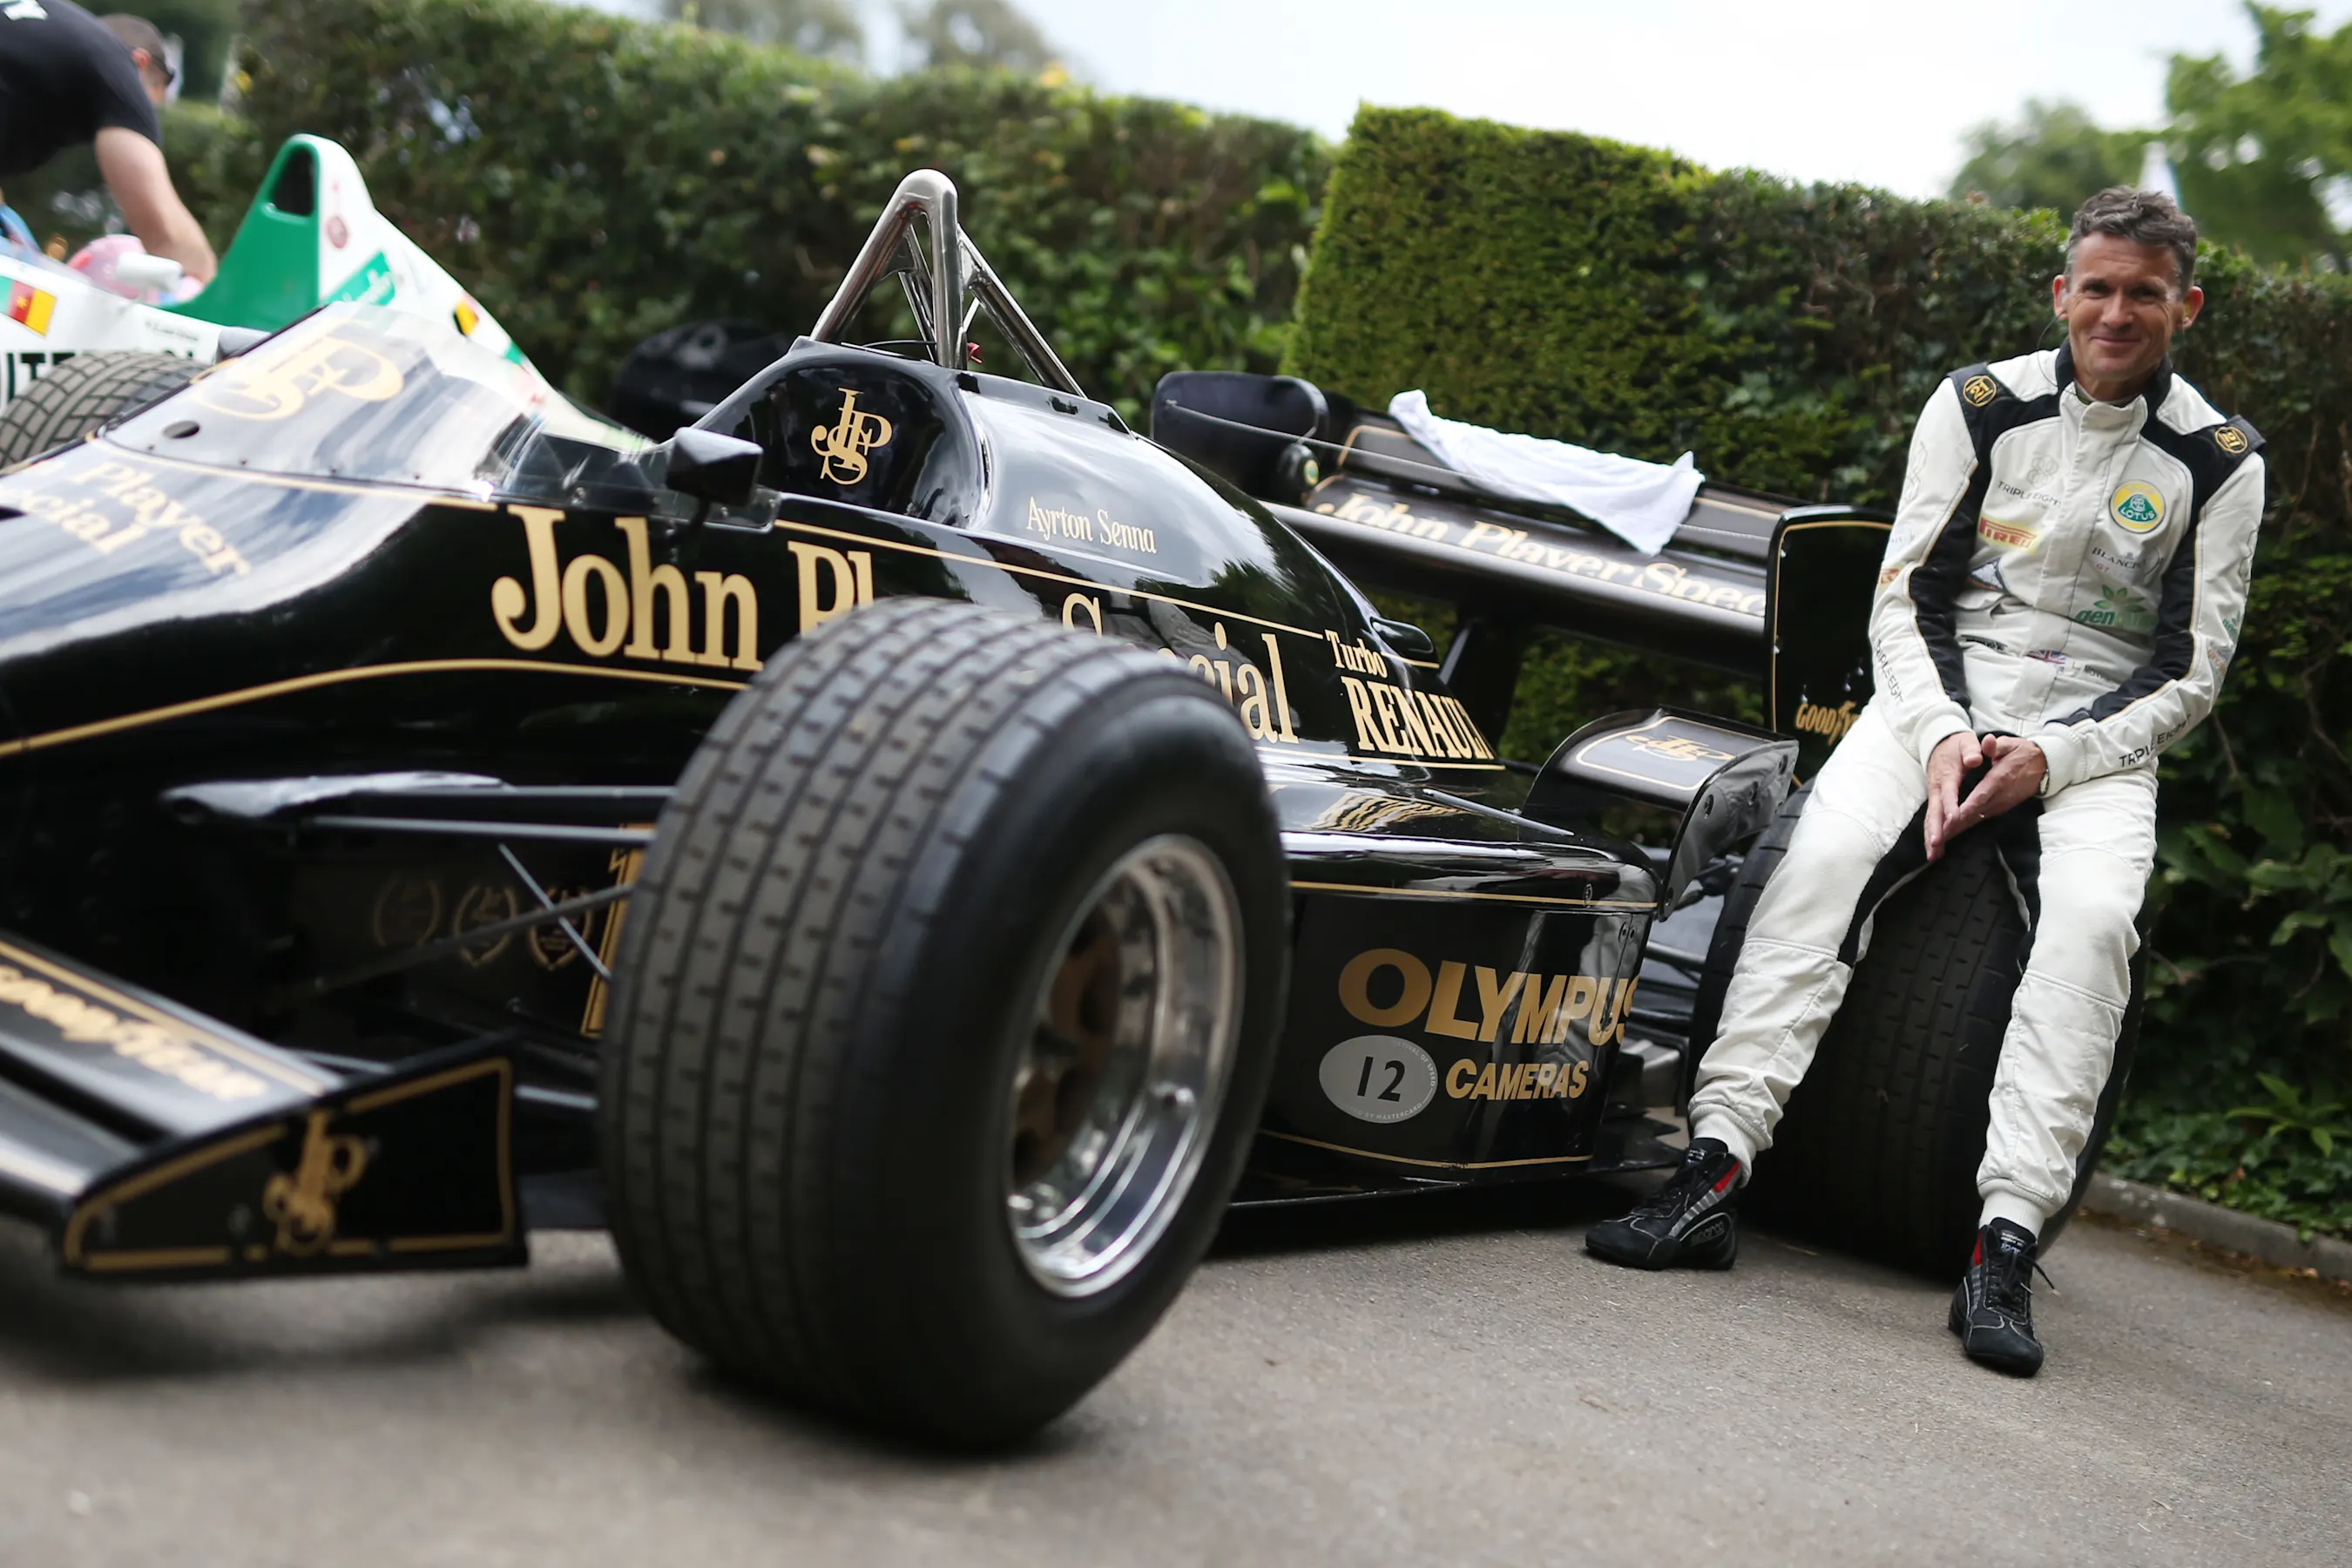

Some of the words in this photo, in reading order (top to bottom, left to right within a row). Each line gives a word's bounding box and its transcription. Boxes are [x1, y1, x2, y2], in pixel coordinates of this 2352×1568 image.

[68, 460, 253, 577] Player
[1026, 496, 1093, 542] Ayrton
[1097, 508, 1157, 554] Senna
[1979, 517, 2037, 548] PIRE
[2120, 506, 2155, 521] LOTUS
[1315, 492, 1450, 541] John
[1634, 562, 1766, 617] Spec
[490, 503, 764, 672] John
[1324, 629, 1388, 679] Turbo
[1357, 1056, 1406, 1102] 12
[1445, 1058, 1590, 1101] CAMERAS
[1375, 1102, 1423, 1120] MASTERCARD
